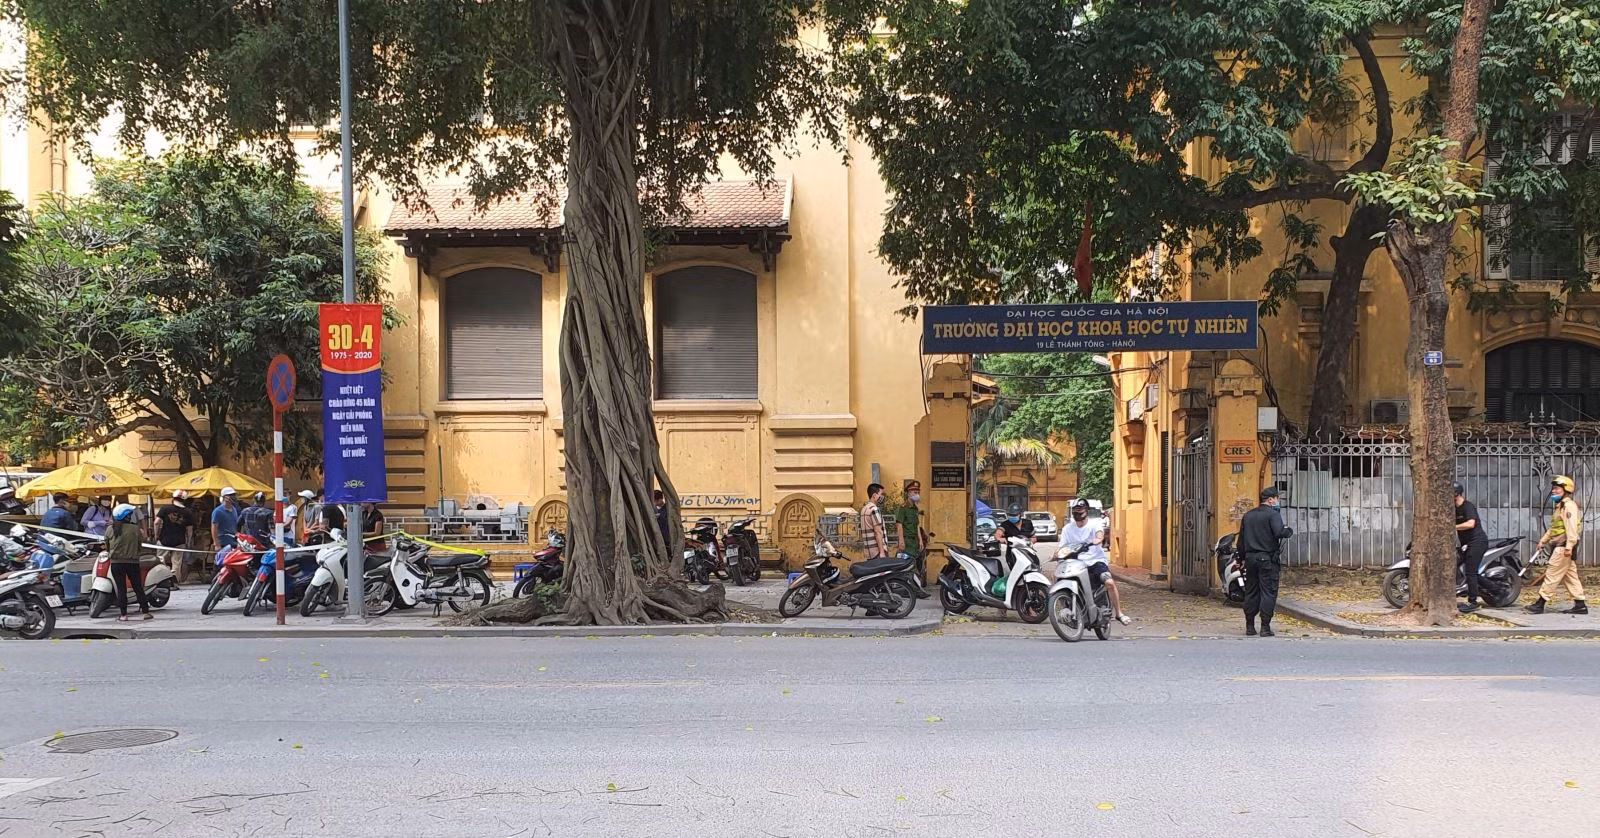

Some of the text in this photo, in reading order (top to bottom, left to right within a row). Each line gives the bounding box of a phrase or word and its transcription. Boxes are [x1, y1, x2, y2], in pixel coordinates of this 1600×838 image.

[1007, 306, 1169, 319] ĐẠI HỌC QUỐC GIA HÀ NỘI
[933, 314, 1248, 340] TRƯỜNG ĐẠI HỌC KHOA HỌC TỰ NHIÊN
[328, 324, 374, 350] 30-4
[1036, 341, 1044, 349] 19
[330, 351, 348, 360] 1975
[353, 351, 373, 359] 2020
[356, 398, 363, 407] 45
[1224, 446, 1252, 455] CRES
